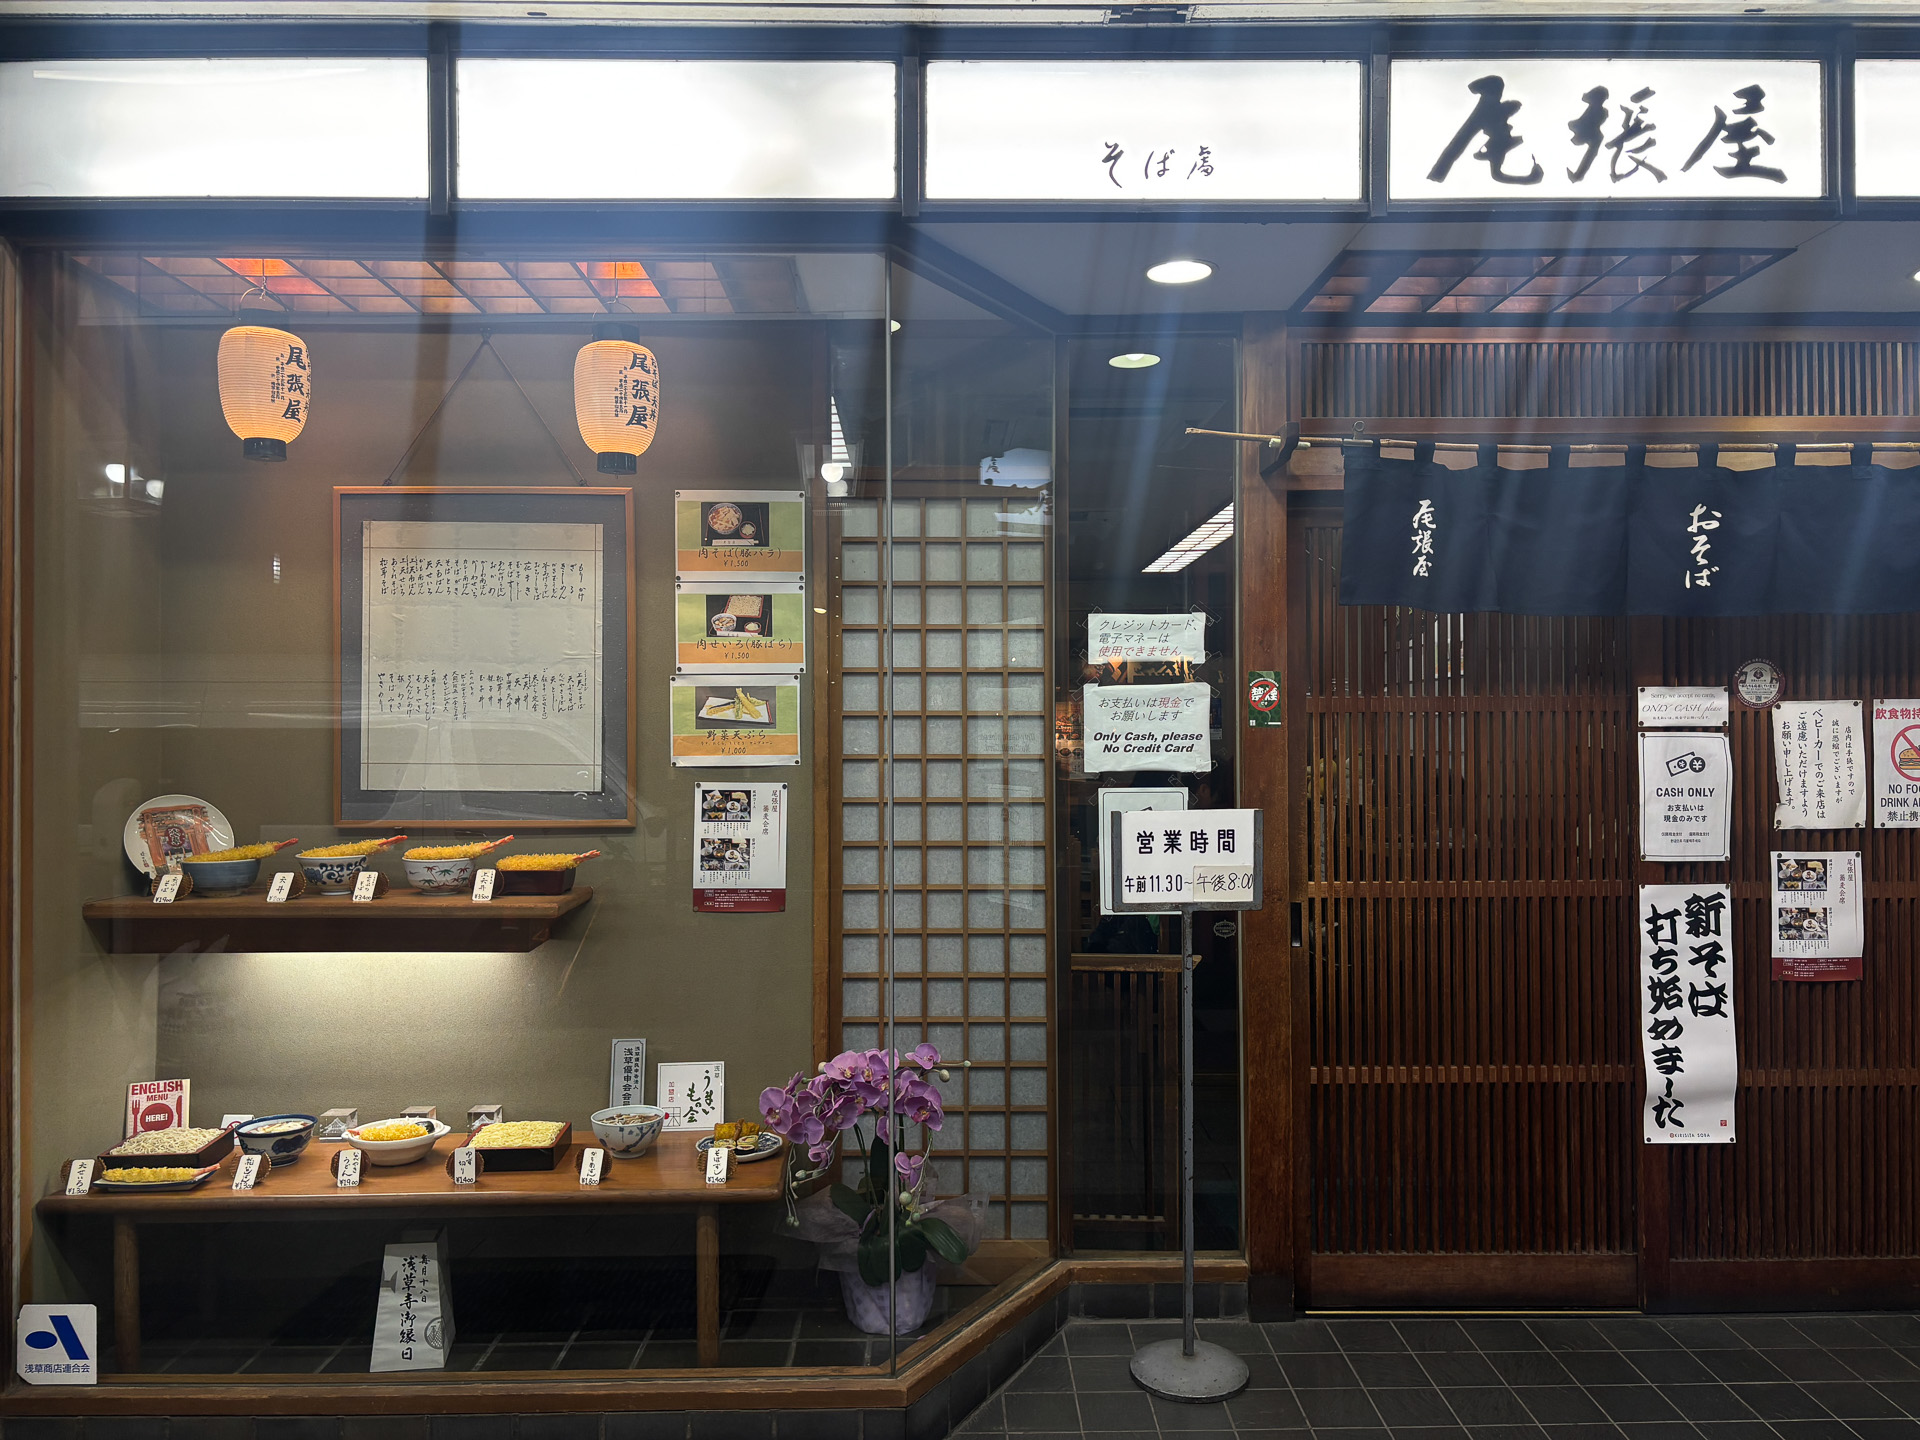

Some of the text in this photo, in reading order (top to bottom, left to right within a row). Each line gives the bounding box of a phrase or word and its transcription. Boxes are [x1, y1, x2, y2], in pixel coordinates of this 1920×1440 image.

[1426, 74, 1788, 185] 尾張屋
[282, 344, 307, 423] 尾張屋
[625, 351, 651, 429] 尾張屋
[1411, 499, 1437, 577] 尾張屋
[1685, 503, 1722, 589] おそば
[698, 547, 782, 559] 肉そば(豚バラ)
[1099, 619, 1197, 631] クレジットカード、
[696, 638, 793, 650] 肉せいろ(豚ばら)
[1098, 633, 1170, 644] 電子マネーは
[1098, 645, 1182, 657] 使用できません
[1098, 696, 1195, 709] お支払いは現金で
[1110, 710, 1183, 721] お願いします
[1642, 701, 1722, 718] ONLY CASH please
[706, 730, 766, 741] 野菜天ぷら
[1093, 731, 1203, 743] Only Cash, please
[1103, 743, 1194, 753] No Credit Card
[1781, 720, 1795, 810] お願い申し上げます。
[1797, 711, 1809, 817] ご遠慮いただけますよう
[1812, 708, 1826, 819] ベビーカーでのご来店は
[1656, 787, 1715, 797] CASH ONLY
[1888, 784, 1920, 794] NO FO
[1667, 804, 1705, 812] お支払いは
[1880, 798, 1920, 808] DRINK A
[1663, 814, 1708, 823] 現金のみです
[1887, 811, 1920, 822] 禁止携
[1136, 829, 1235, 854] 営業時間
[1684, 892, 1728, 1018] 新そば
[1645, 904, 1684, 1128] 打ち始めました
[131, 1080, 183, 1095] ENGLISH
[701, 1069, 715, 1115] うまい
[146, 1093, 169, 1102] MENU
[145, 1113, 168, 1122] HERE!
[419, 1254, 430, 1303] 毎月十八日
[400, 1255, 418, 1361] 浅草寺御縁日
[24, 1363, 91, 1374] 浅草商店連合会
